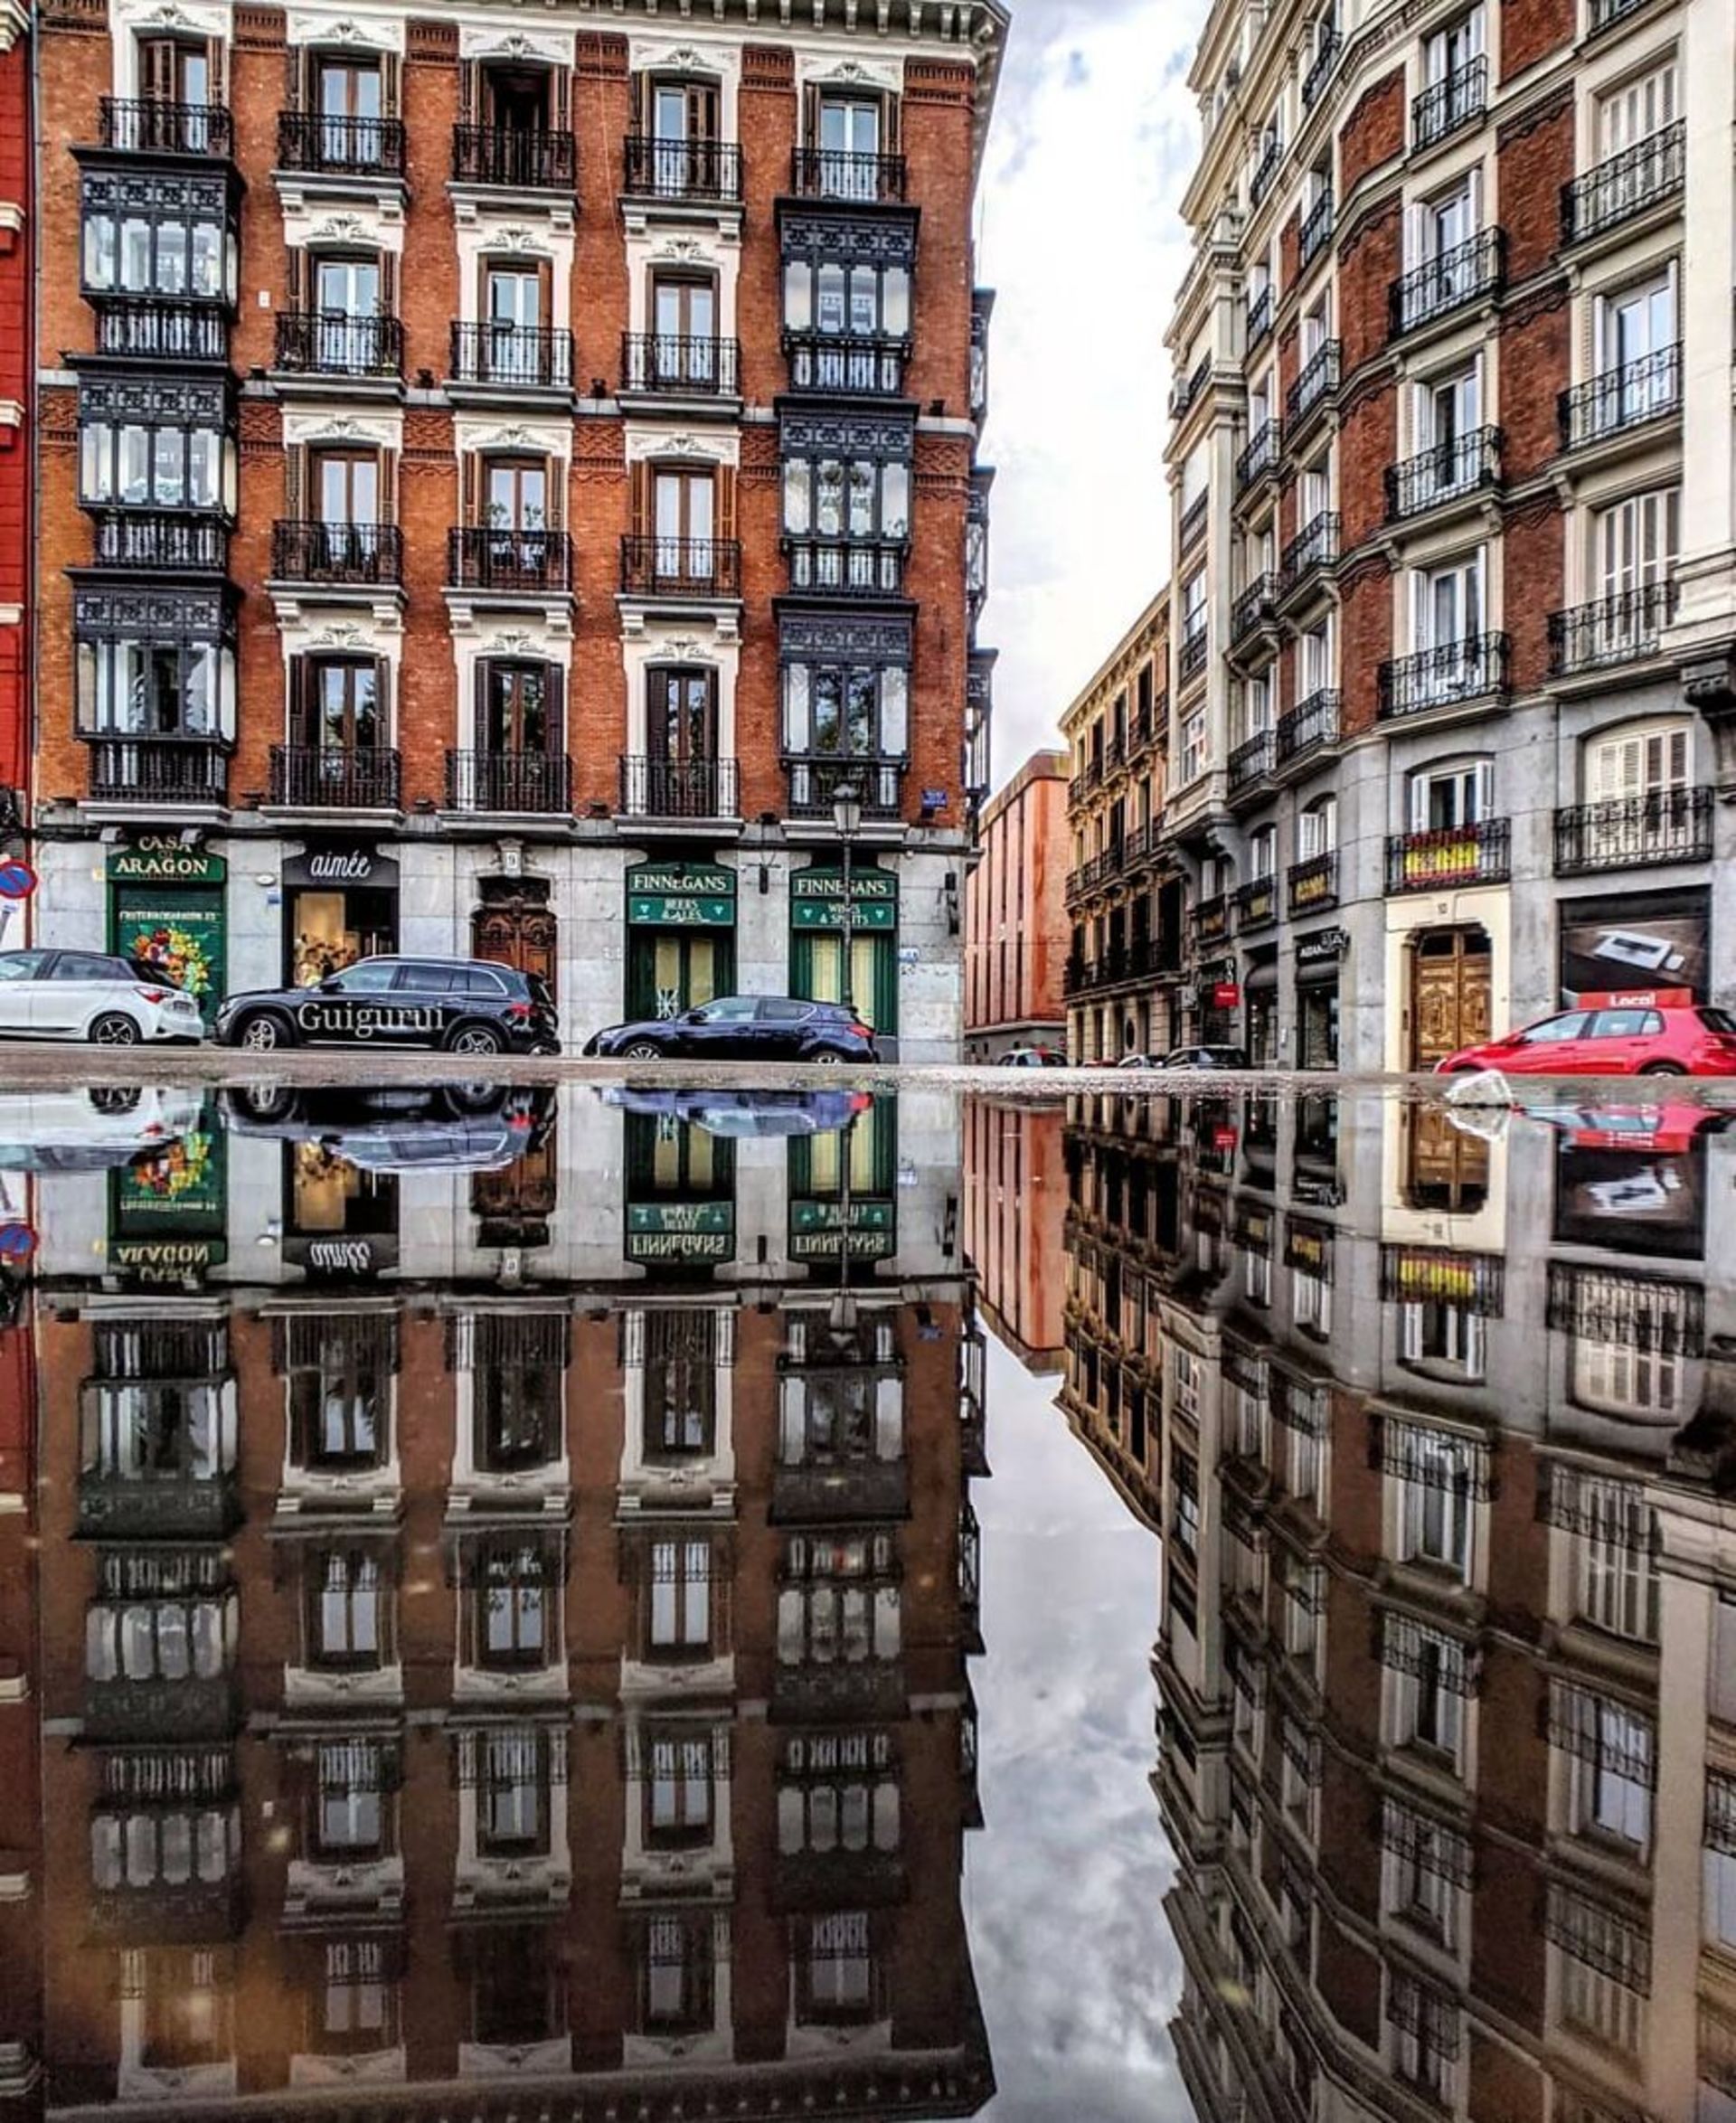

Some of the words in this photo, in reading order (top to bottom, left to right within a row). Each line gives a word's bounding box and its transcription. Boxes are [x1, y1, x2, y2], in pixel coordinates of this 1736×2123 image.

[138, 835, 193, 854] CASA
[115, 857, 209, 874] ARAGON
[310, 849, 372, 877] aimée
